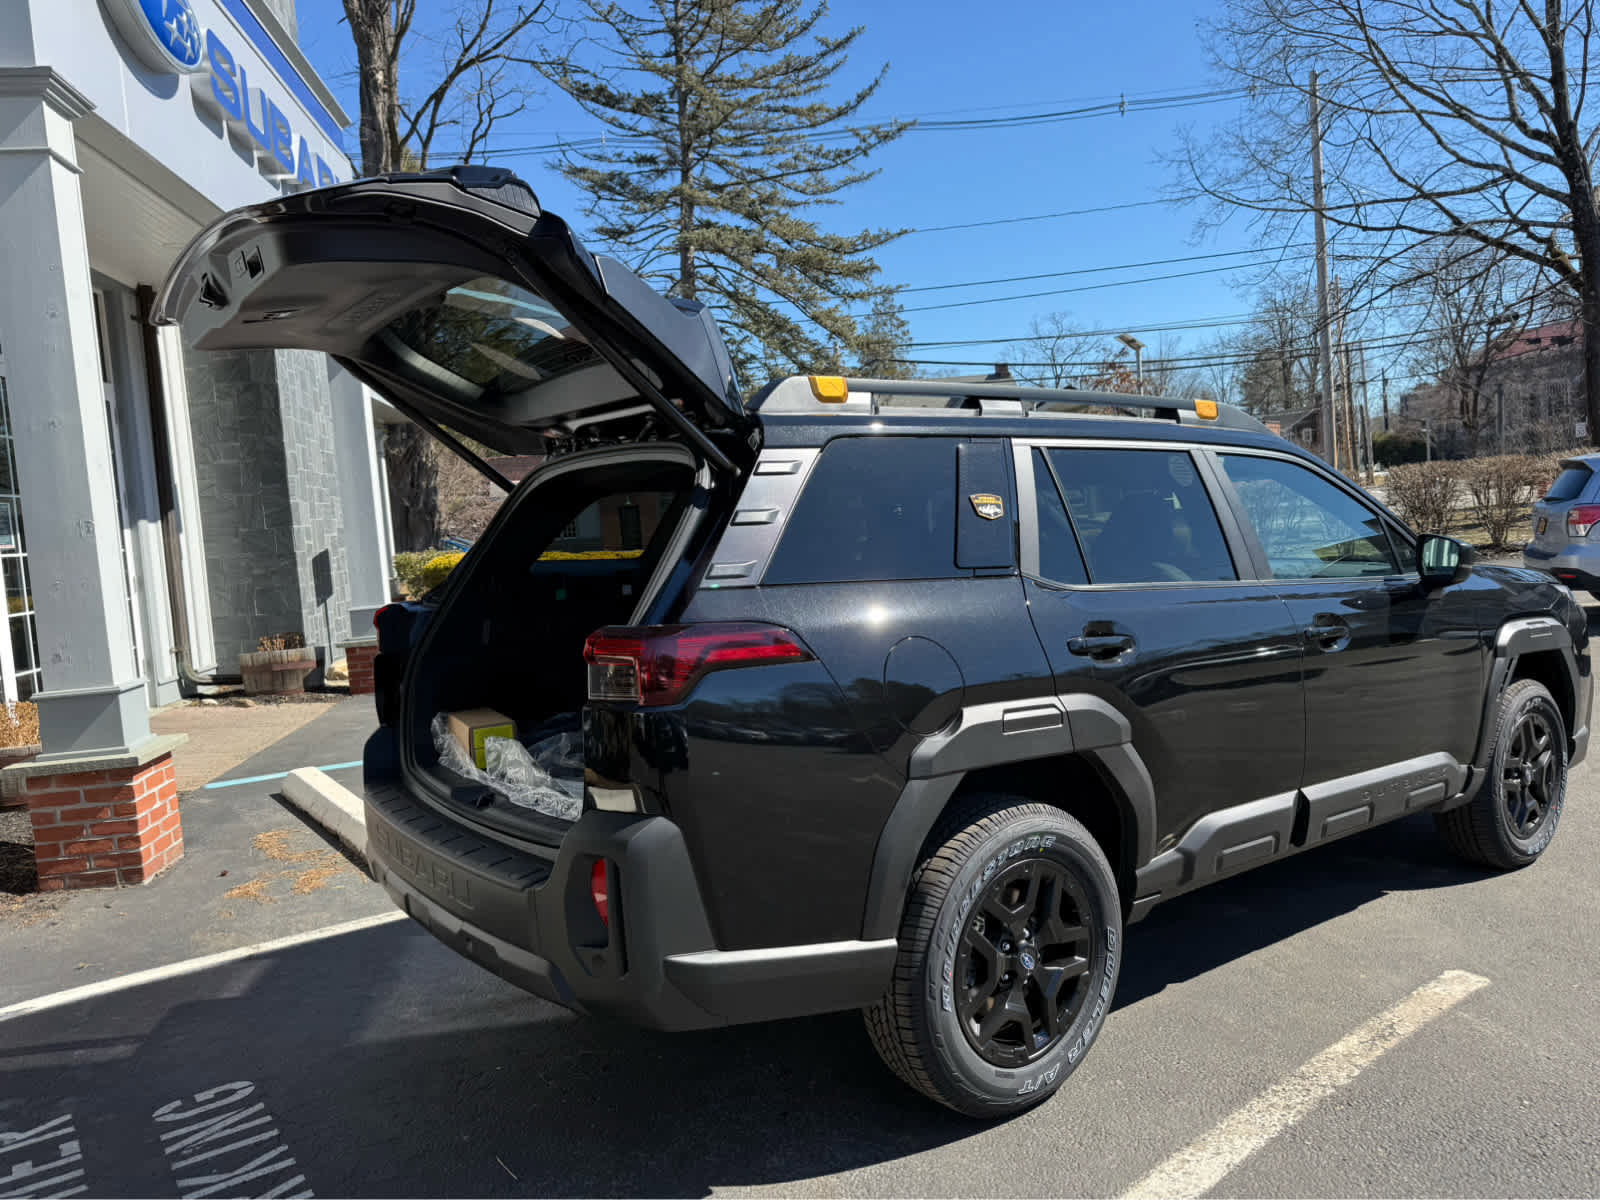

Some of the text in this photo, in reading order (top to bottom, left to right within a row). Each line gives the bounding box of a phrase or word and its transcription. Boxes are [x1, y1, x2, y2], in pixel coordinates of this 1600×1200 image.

[206, 28, 340, 189] SUBAR
[375, 822, 475, 910] SUBARU
[942, 835, 1057, 1013] BRIDGESTONE
[1017, 926, 1117, 1095] DUELER A/T
